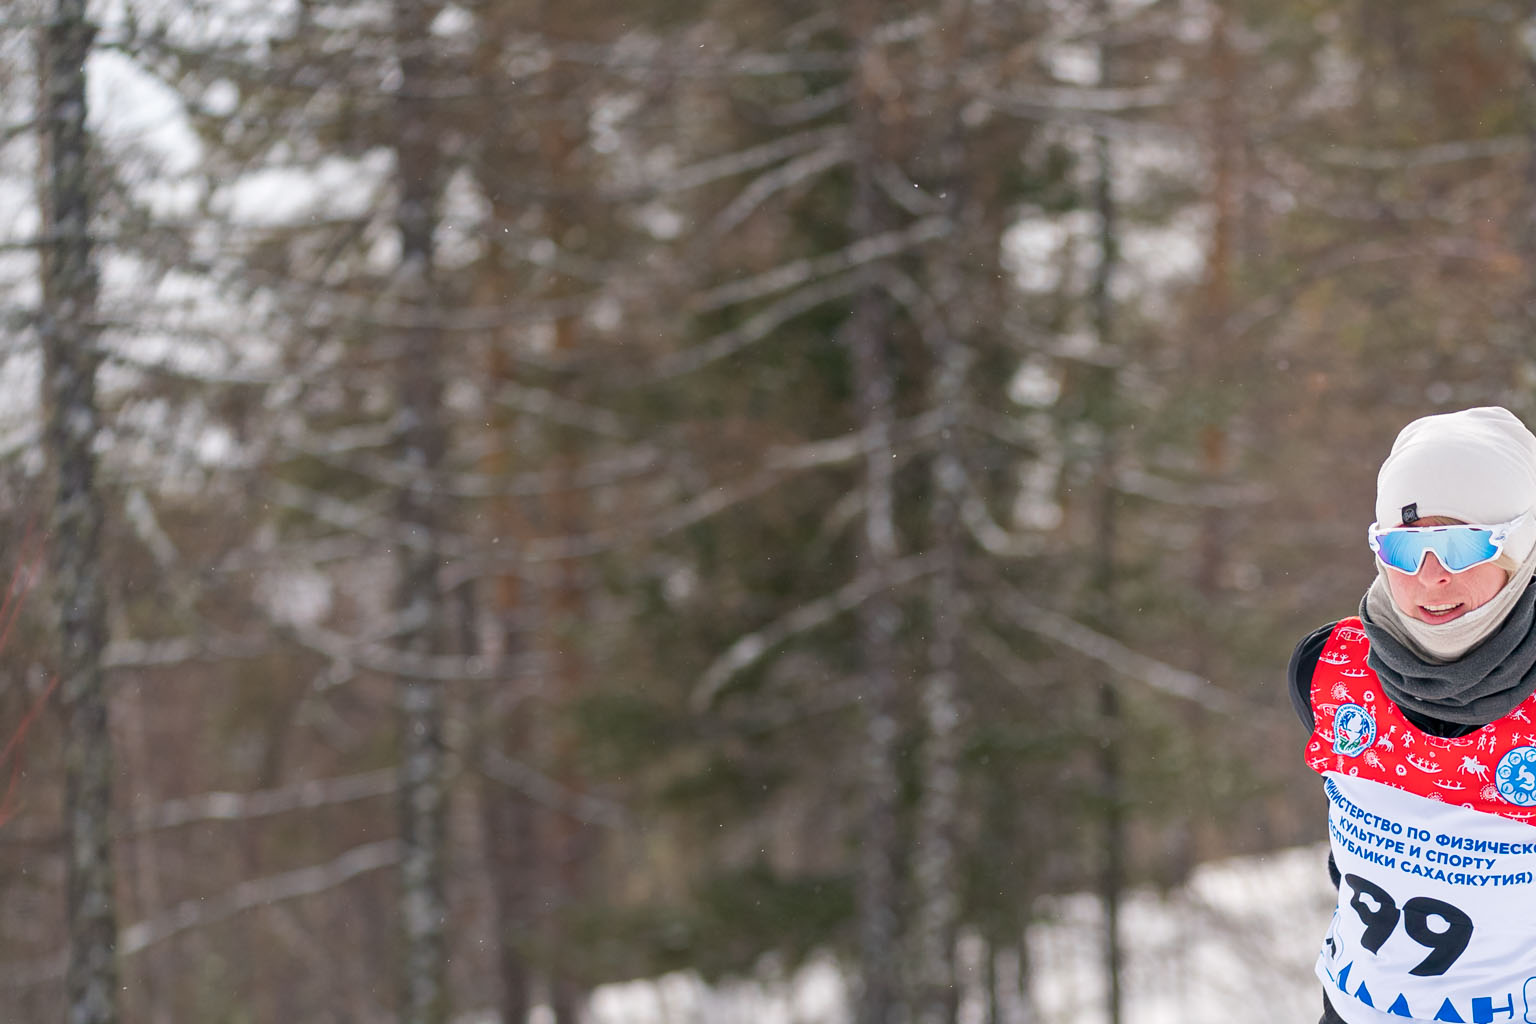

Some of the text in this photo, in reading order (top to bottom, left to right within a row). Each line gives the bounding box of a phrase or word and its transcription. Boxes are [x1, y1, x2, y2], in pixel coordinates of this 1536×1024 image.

[1339, 815, 1496, 870] КУЛЬТУРЕ И СПОРТУ
[1406, 826, 1431, 842] ПО
[1400, 860, 1533, 887] САХА(ЯКУТИЯ)
[1344, 872, 1475, 977] 99
